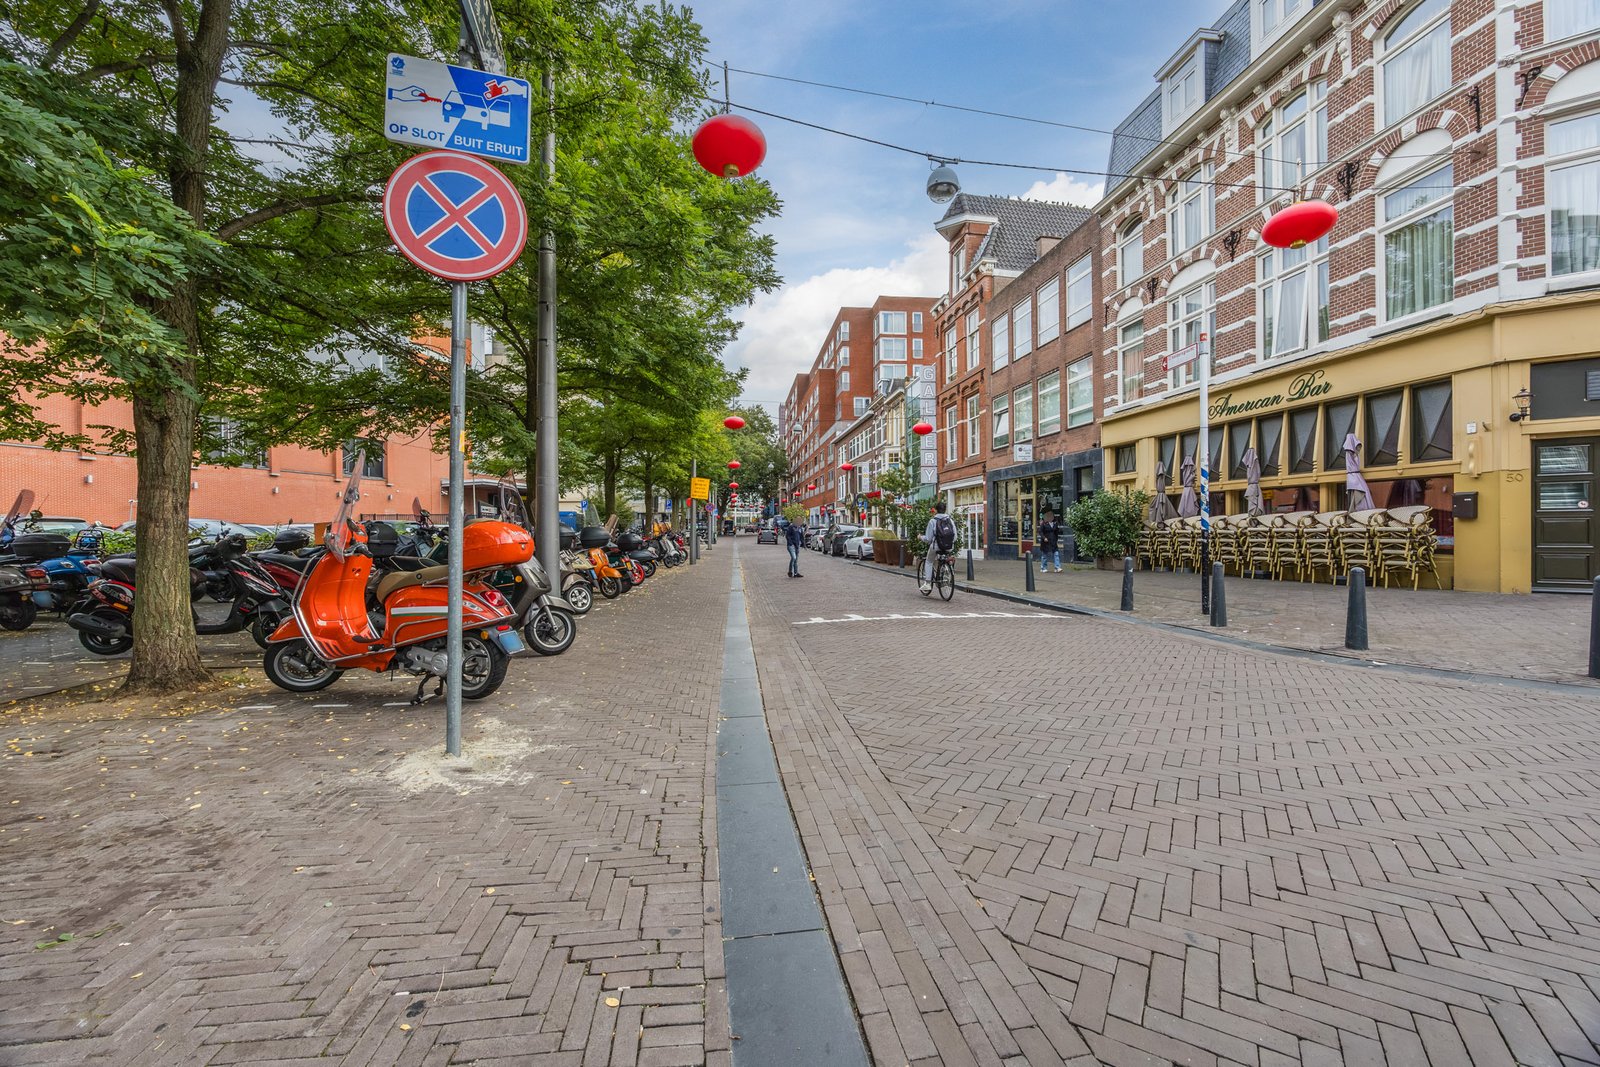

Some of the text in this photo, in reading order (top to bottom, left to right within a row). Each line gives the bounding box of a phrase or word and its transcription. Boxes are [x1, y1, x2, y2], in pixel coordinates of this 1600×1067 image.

[389, 123, 445, 142] OP SLOT
[454, 135, 523, 156] BUIT ERUIT
[1207, 369, 1333, 420] American Bar
[1505, 473, 1524, 483] 50
